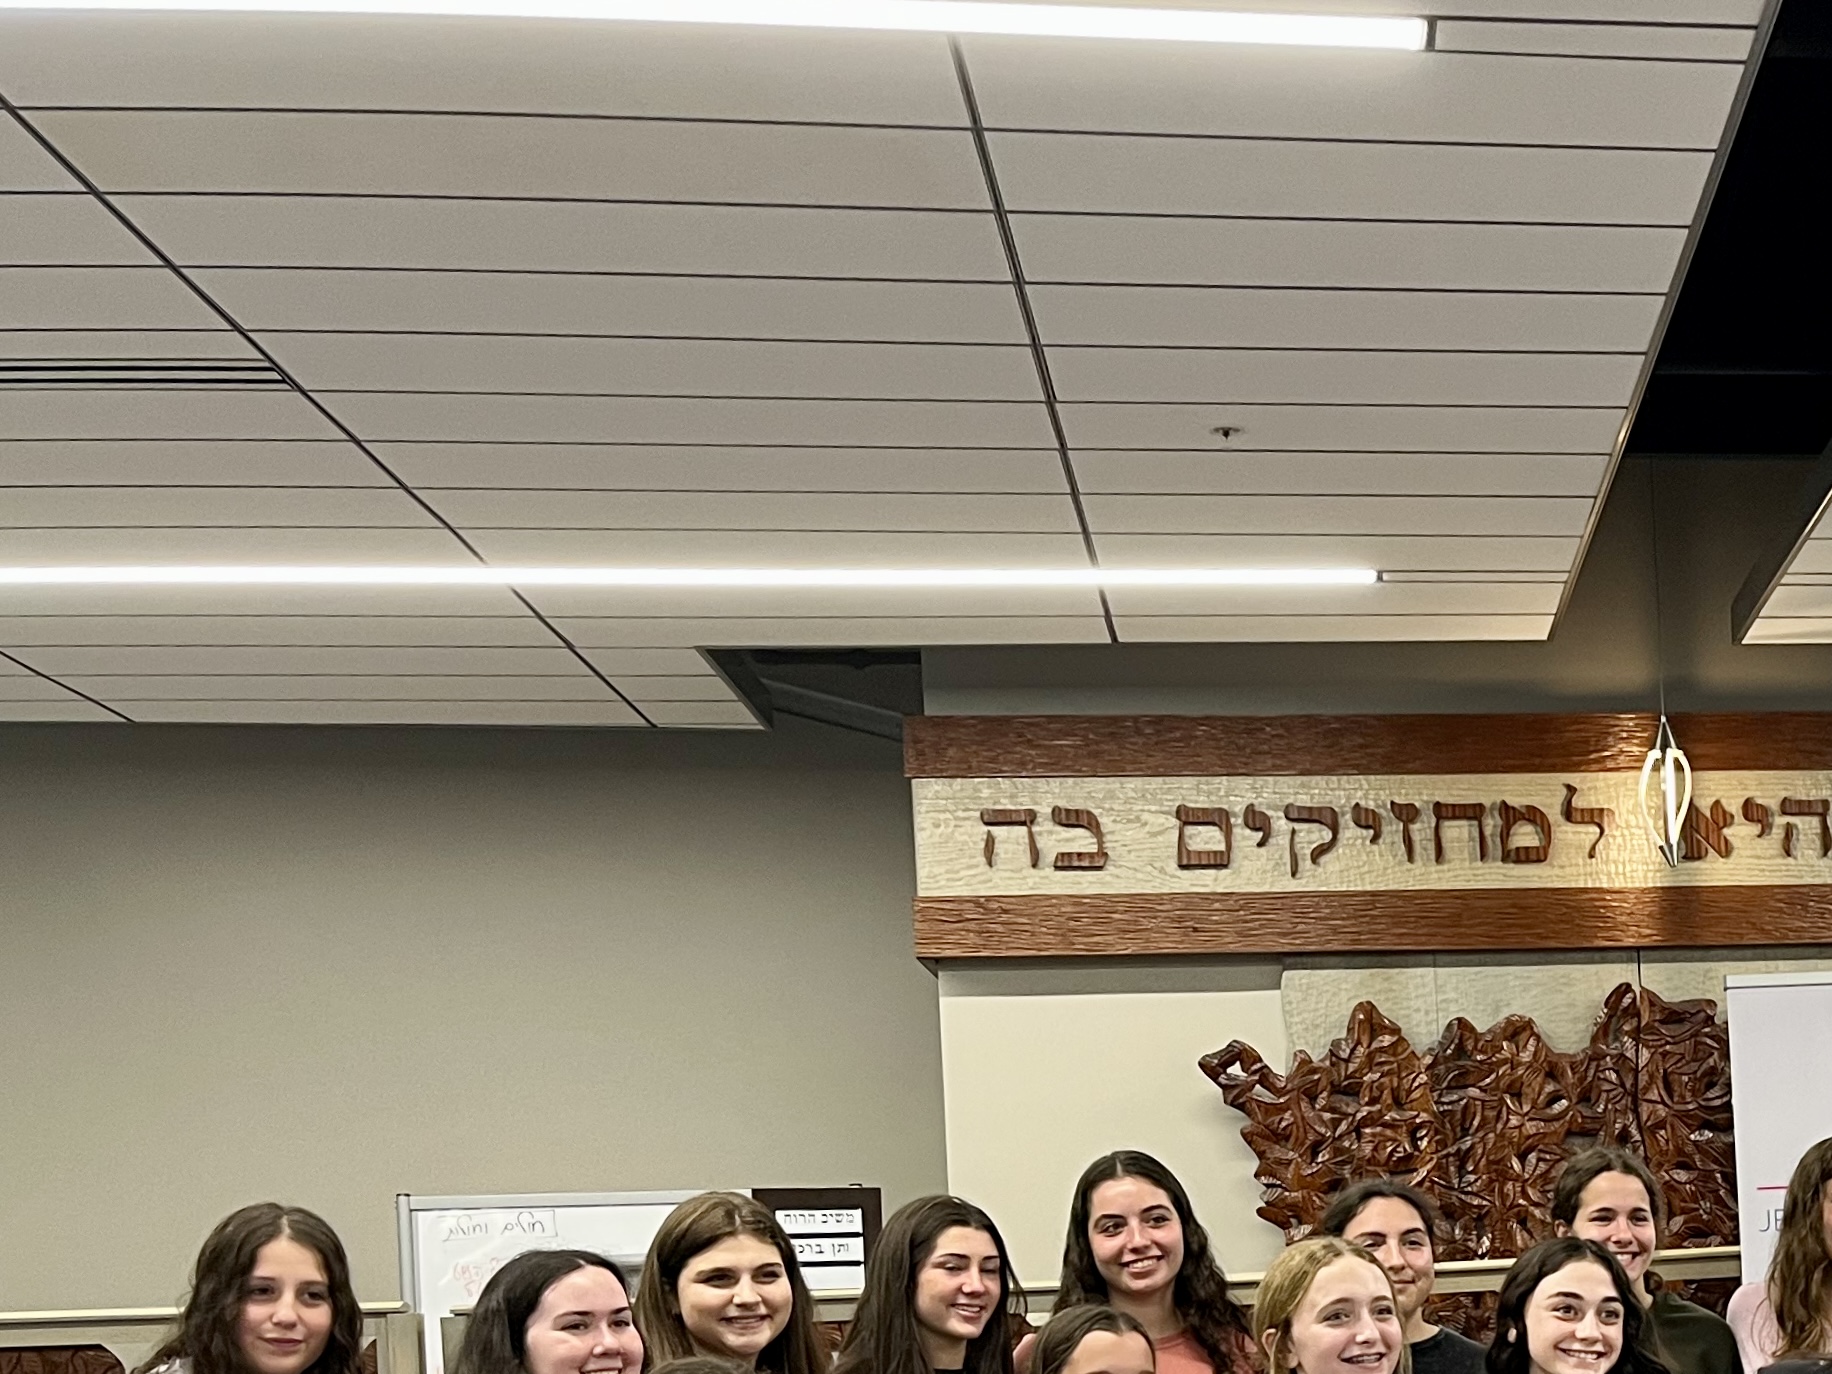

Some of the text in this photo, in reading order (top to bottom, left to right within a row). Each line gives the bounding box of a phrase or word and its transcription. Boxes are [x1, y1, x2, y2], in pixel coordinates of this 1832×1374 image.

[980, 804, 1108, 870] בה
[1174, 782, 1615, 879] למחזיקים
[1681, 796, 1832, 860] היא
